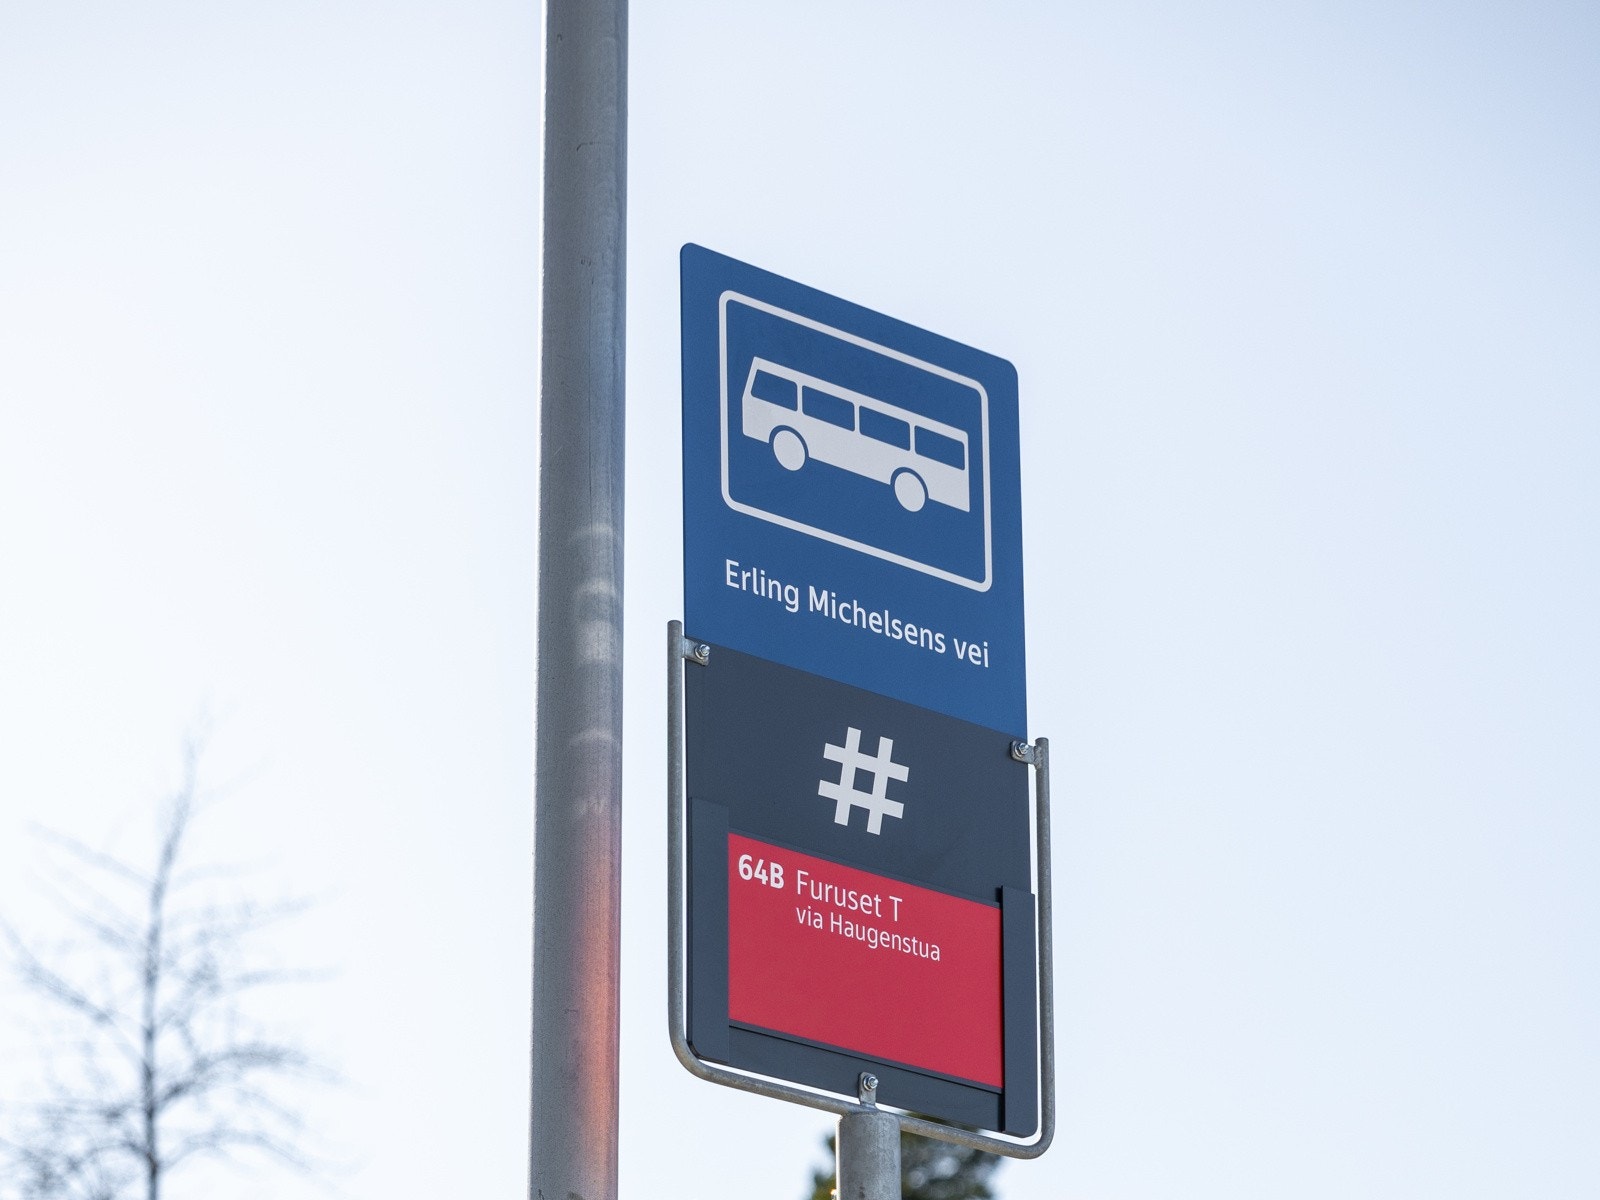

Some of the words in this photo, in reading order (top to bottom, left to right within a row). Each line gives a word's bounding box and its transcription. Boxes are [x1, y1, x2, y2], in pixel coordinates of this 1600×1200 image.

[726, 558, 800, 612] Erling
[808, 585, 946, 654] Michelsens
[954, 637, 990, 668] vei
[738, 853, 784, 889] 64B
[797, 870, 882, 918] Furuset
[889, 895, 902, 922] T
[796, 906, 823, 930] via
[830, 914, 940, 962] Haugenstua
